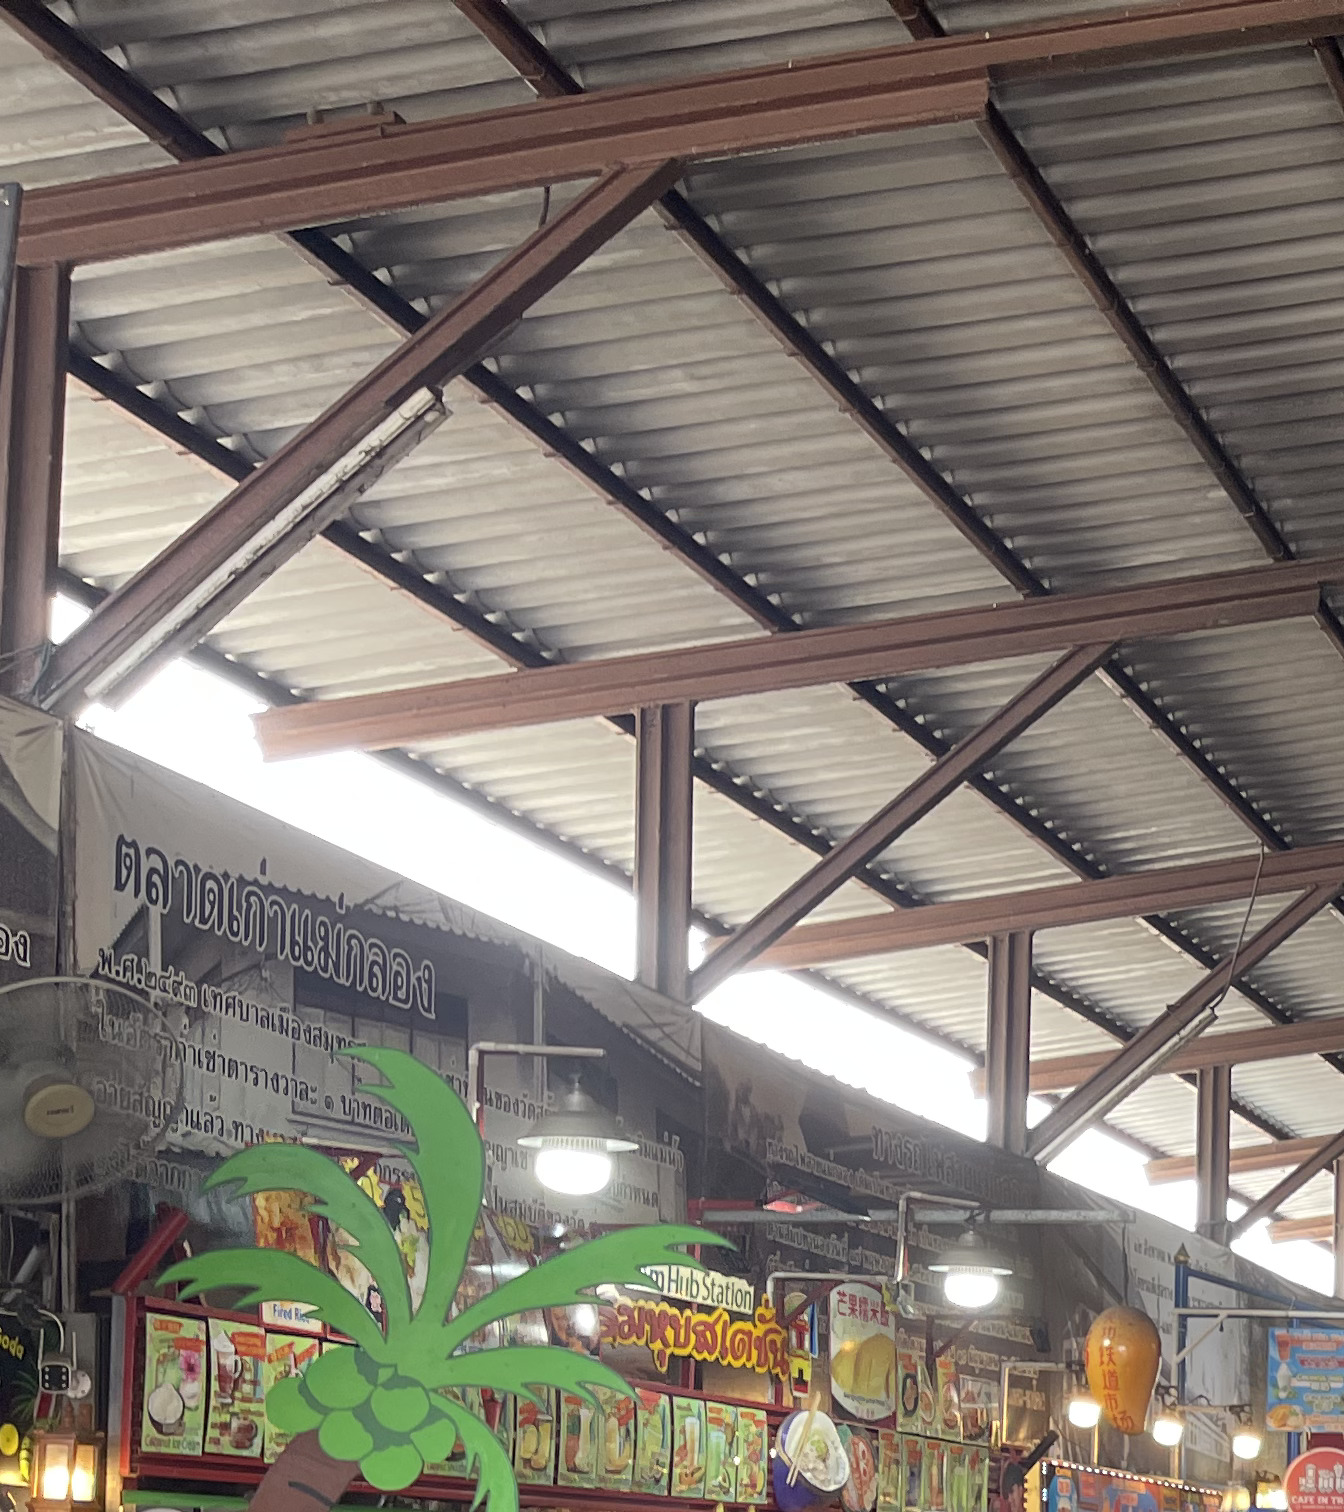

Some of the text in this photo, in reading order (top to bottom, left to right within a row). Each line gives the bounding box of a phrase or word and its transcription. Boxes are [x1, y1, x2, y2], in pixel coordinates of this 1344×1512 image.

[114, 833, 436, 1019] ตลาดเก่าแม่กลอง
[668, 1265, 700, 1299] Hub
[702, 1271, 752, 1310] Station
[272, 1303, 293, 1321] Fired
[0, 1327, 25, 1360] oda
[1291, 1495, 1315, 1504] CAFE
[1318, 1495, 1329, 1504] IN
